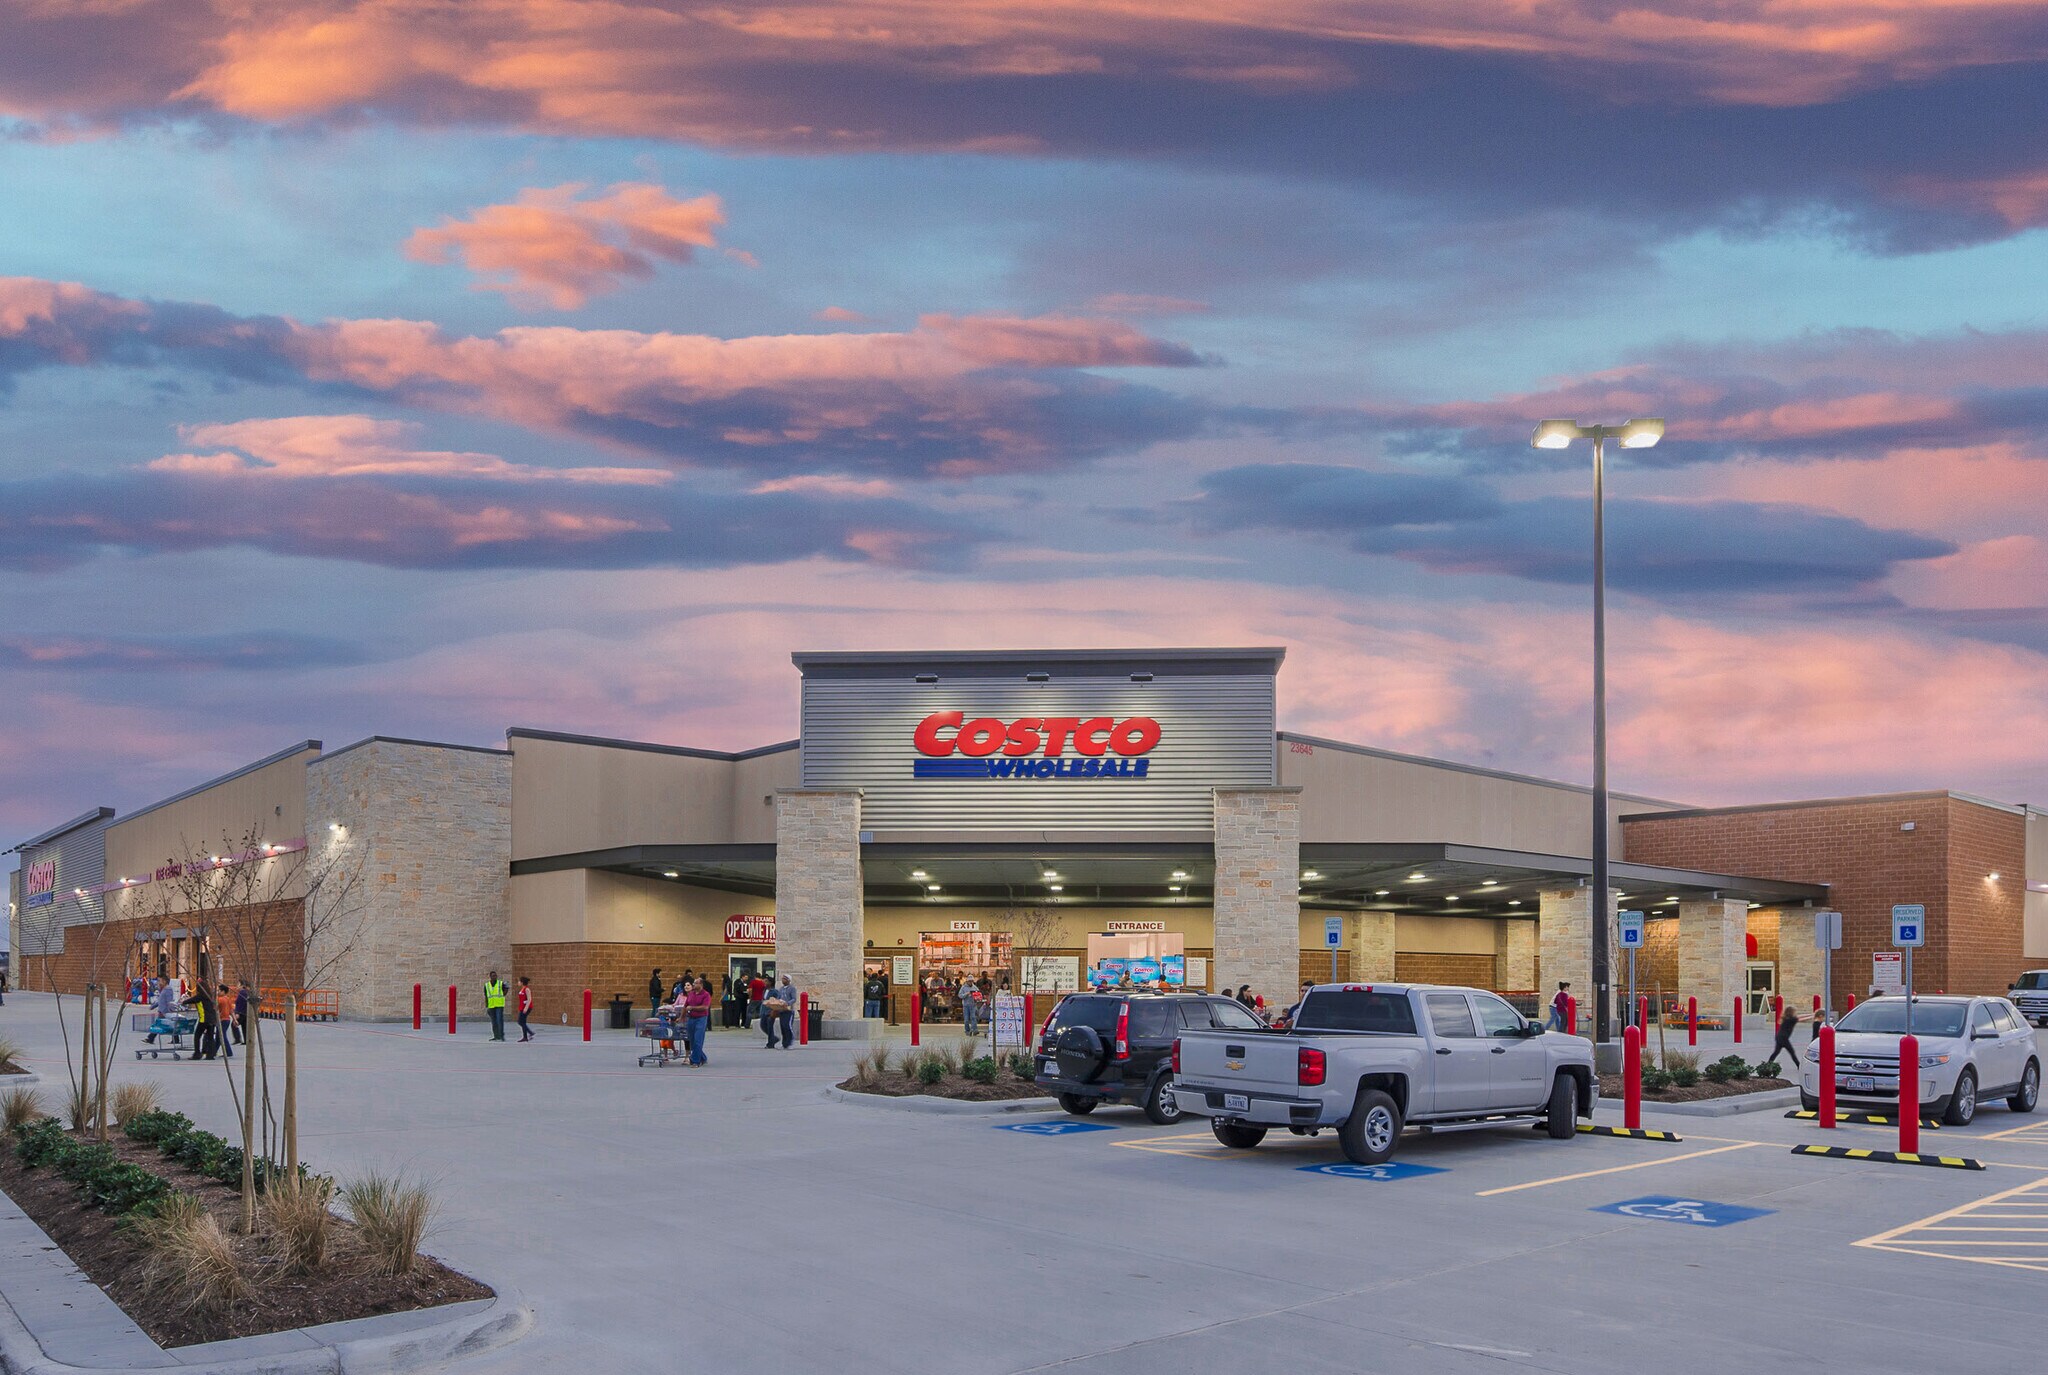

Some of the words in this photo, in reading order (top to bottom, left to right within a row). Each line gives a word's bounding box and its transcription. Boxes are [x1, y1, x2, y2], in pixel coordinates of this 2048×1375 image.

[913, 710, 1162, 757] COSTCO
[987, 758, 1149, 778] WHOLESALE
[726, 921, 776, 939] OPTOMETR
[1109, 922, 1163, 930] ENTRANCE
[1061, 1049, 1086, 1059] HONDA
